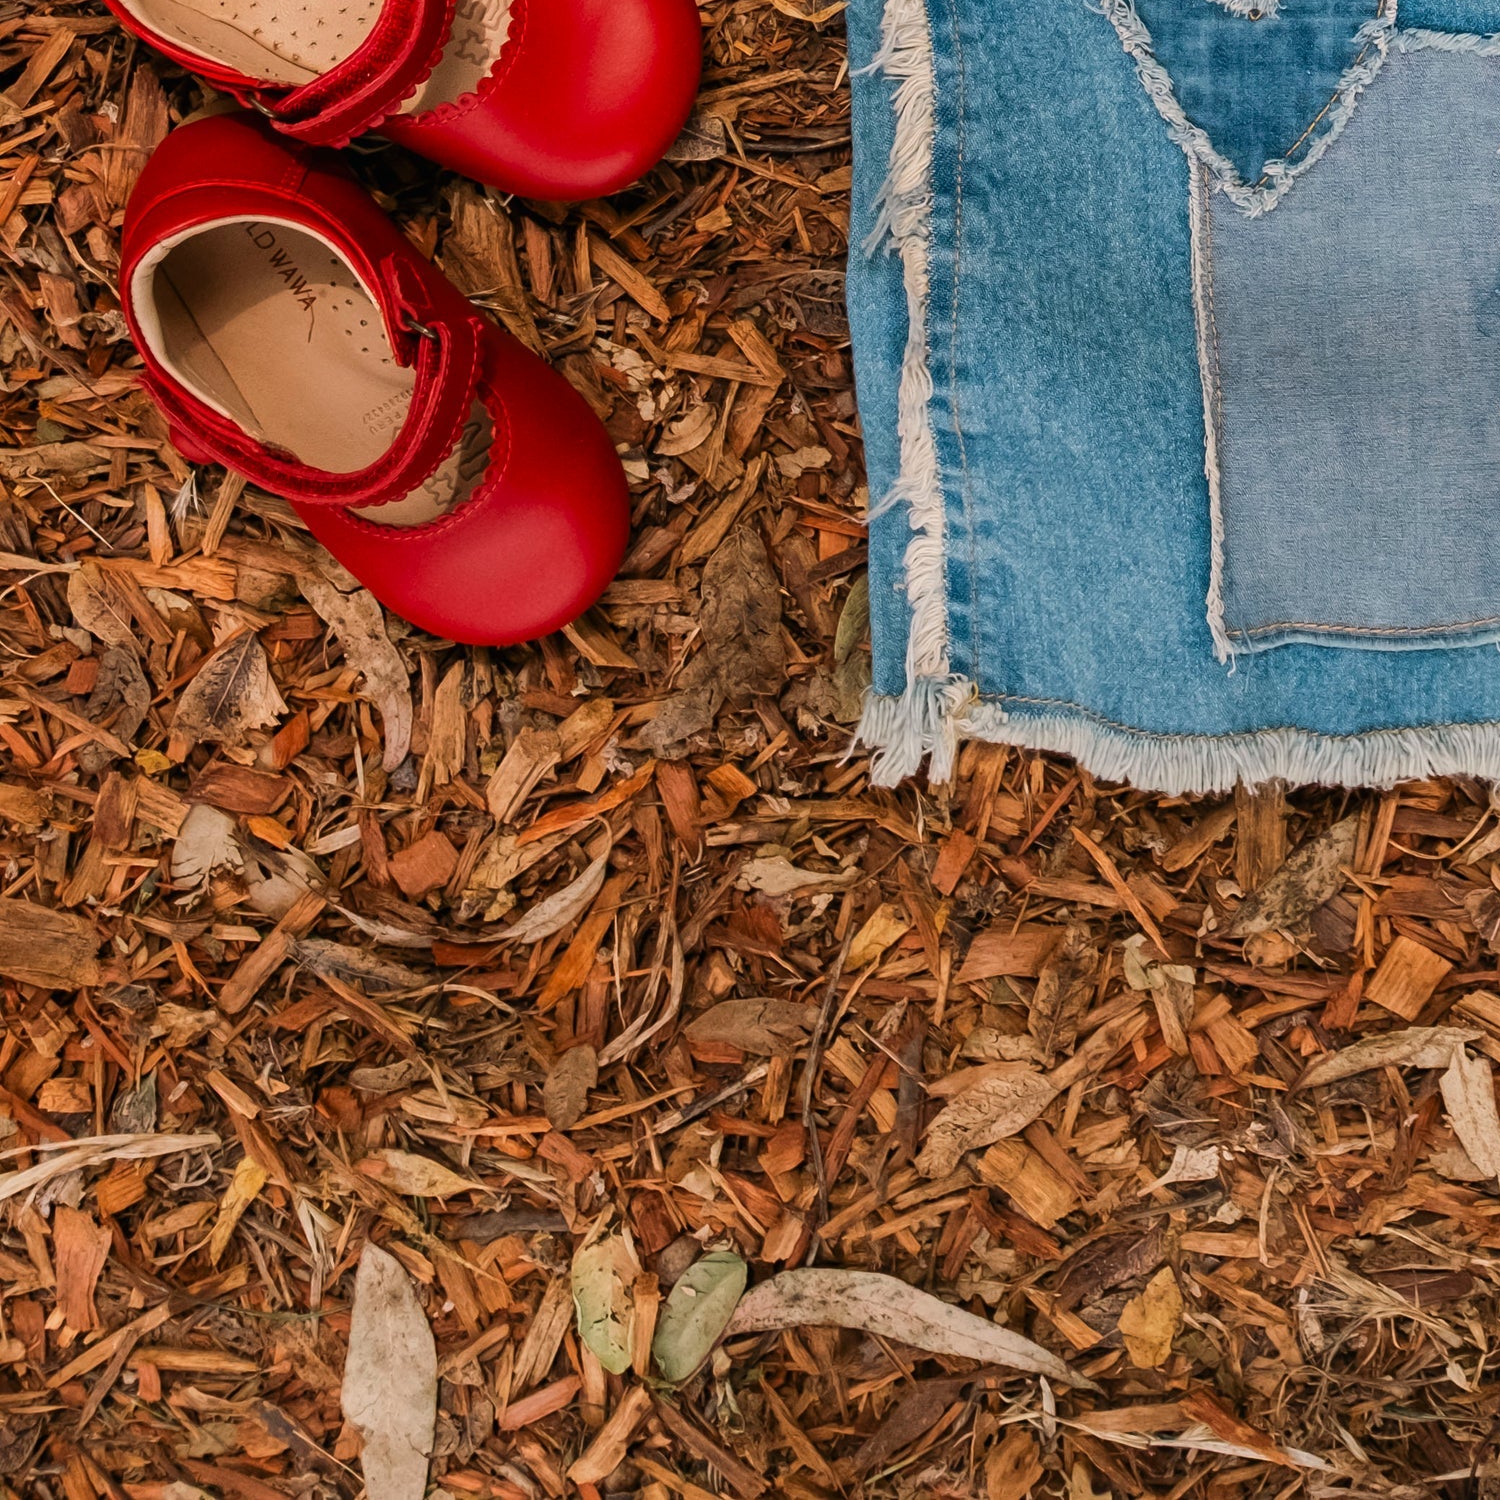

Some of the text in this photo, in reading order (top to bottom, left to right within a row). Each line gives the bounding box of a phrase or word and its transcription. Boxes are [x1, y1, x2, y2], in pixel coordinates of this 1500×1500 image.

[242, 222, 317, 312] LD WAWA
[369, 411, 402, 436] PERU
